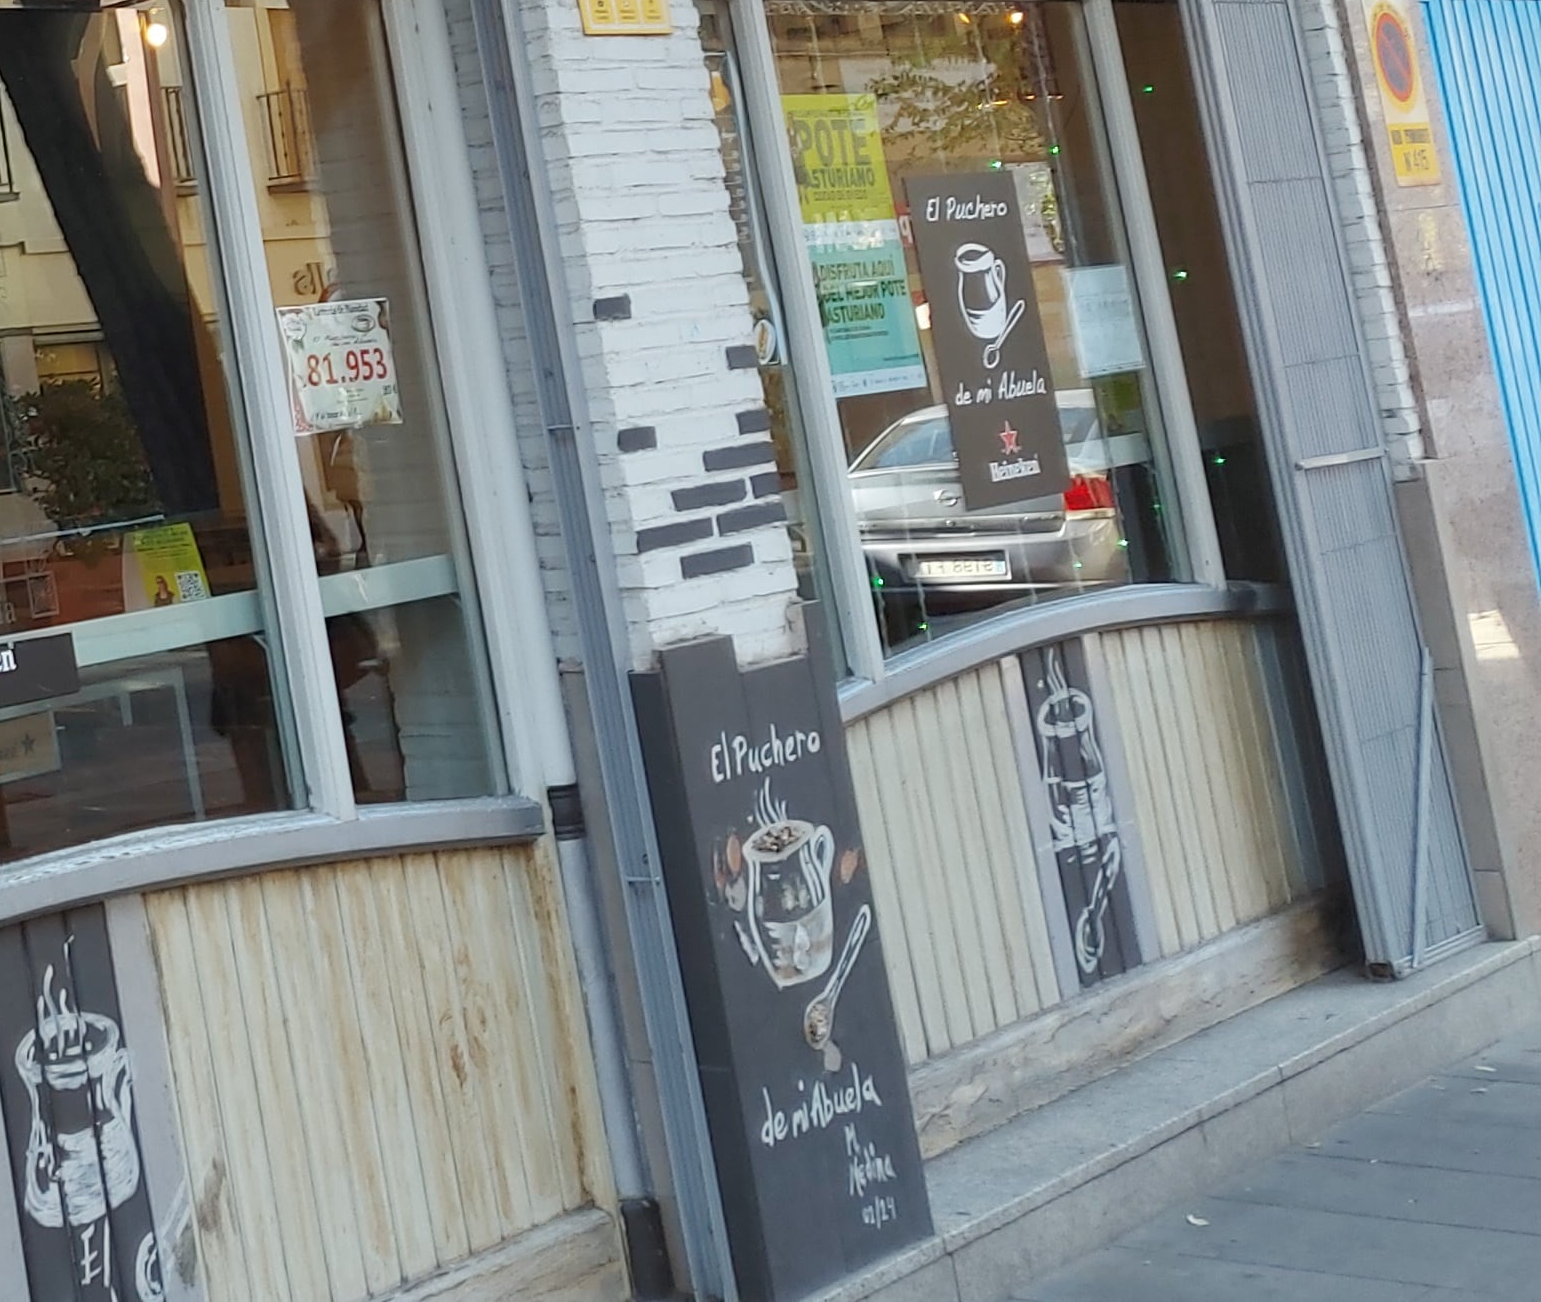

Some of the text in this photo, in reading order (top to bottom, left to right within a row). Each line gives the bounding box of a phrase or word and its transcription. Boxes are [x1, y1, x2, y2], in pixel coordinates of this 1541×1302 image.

[793, 118, 872, 168] POTE
[925, 195, 1008, 223] El Puchero
[881, 278, 907, 297] POTE
[306, 347, 388, 387] 81.953
[955, 382, 974, 407] de
[976, 378, 994, 404] mi
[997, 375, 1048, 400] Abuela
[988, 455, 1042, 483] Heineken
[710, 722, 822, 784] El Puchero
[760, 1063, 882, 1147] de mi Abuela
